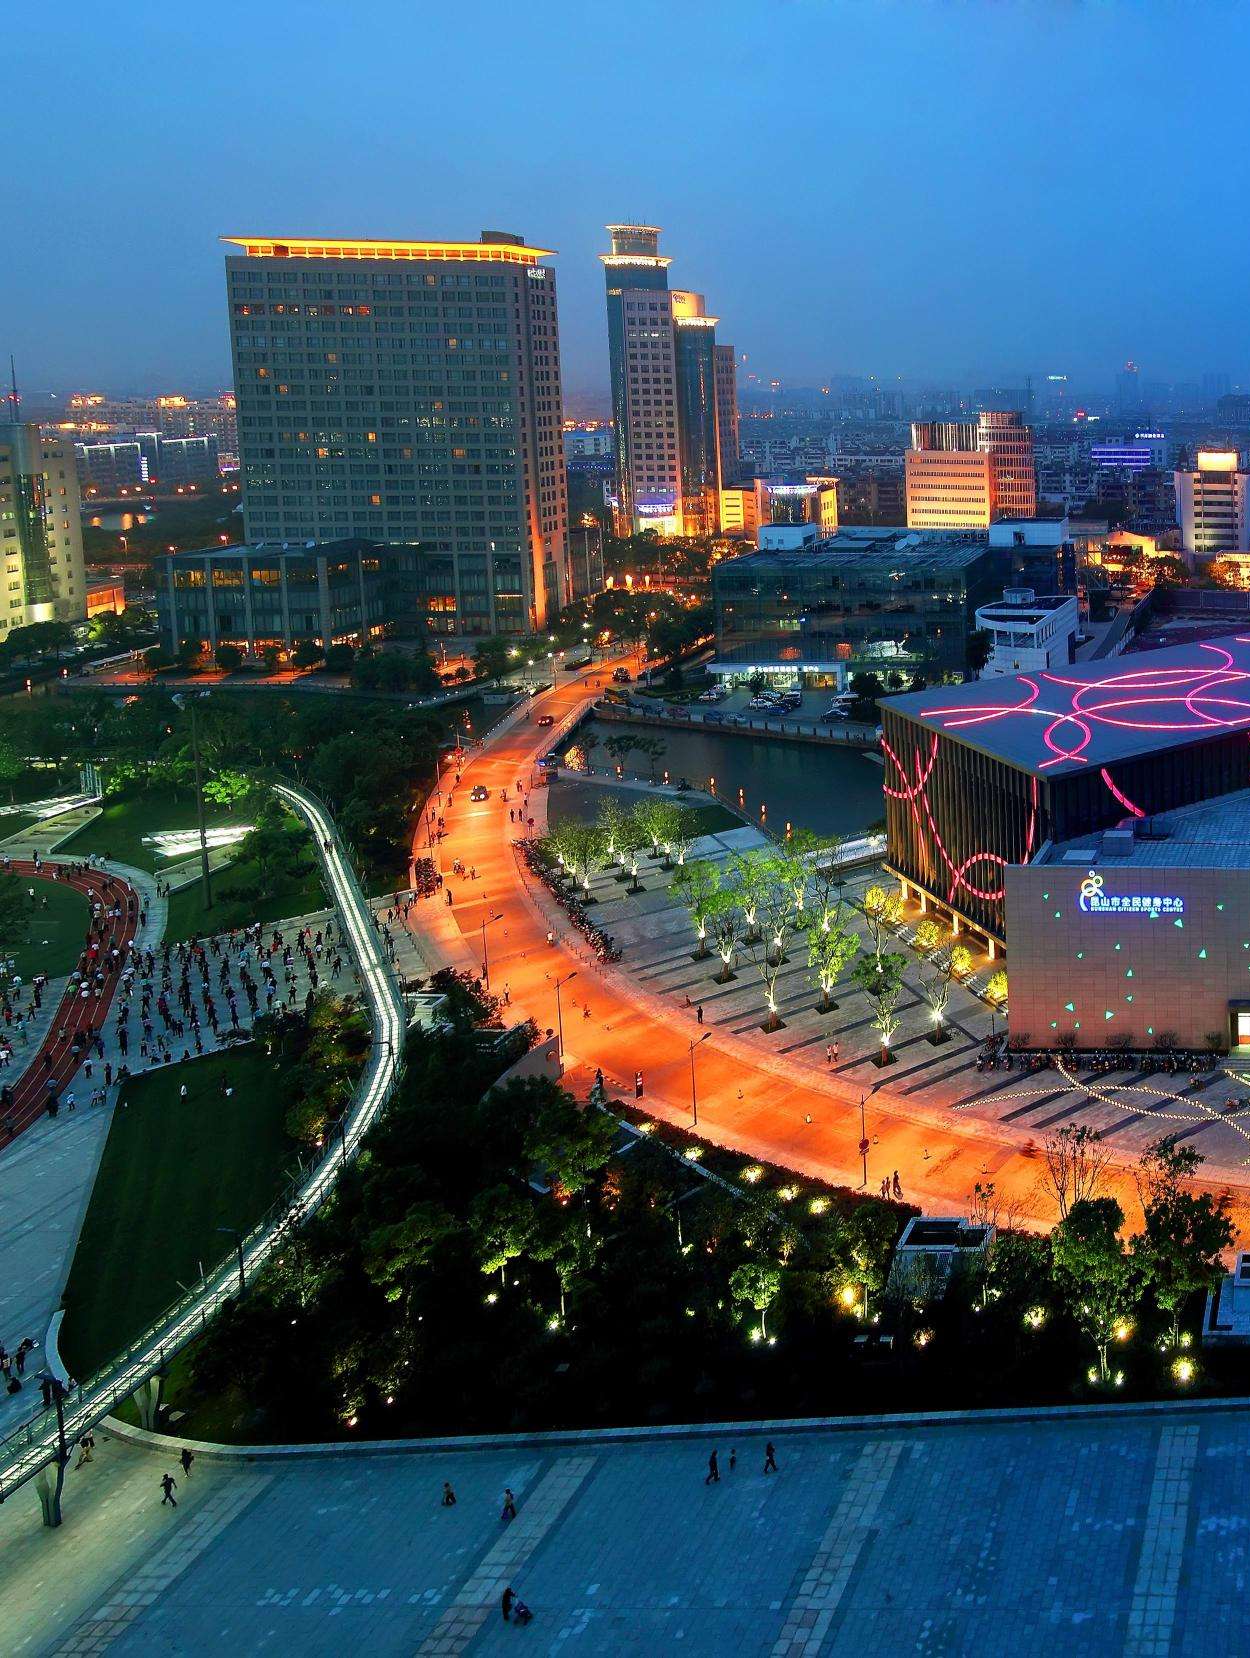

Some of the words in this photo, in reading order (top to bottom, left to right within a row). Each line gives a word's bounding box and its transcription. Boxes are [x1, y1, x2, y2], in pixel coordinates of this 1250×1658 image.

[1090, 896, 1184, 907] 昆山市全民健身中心
